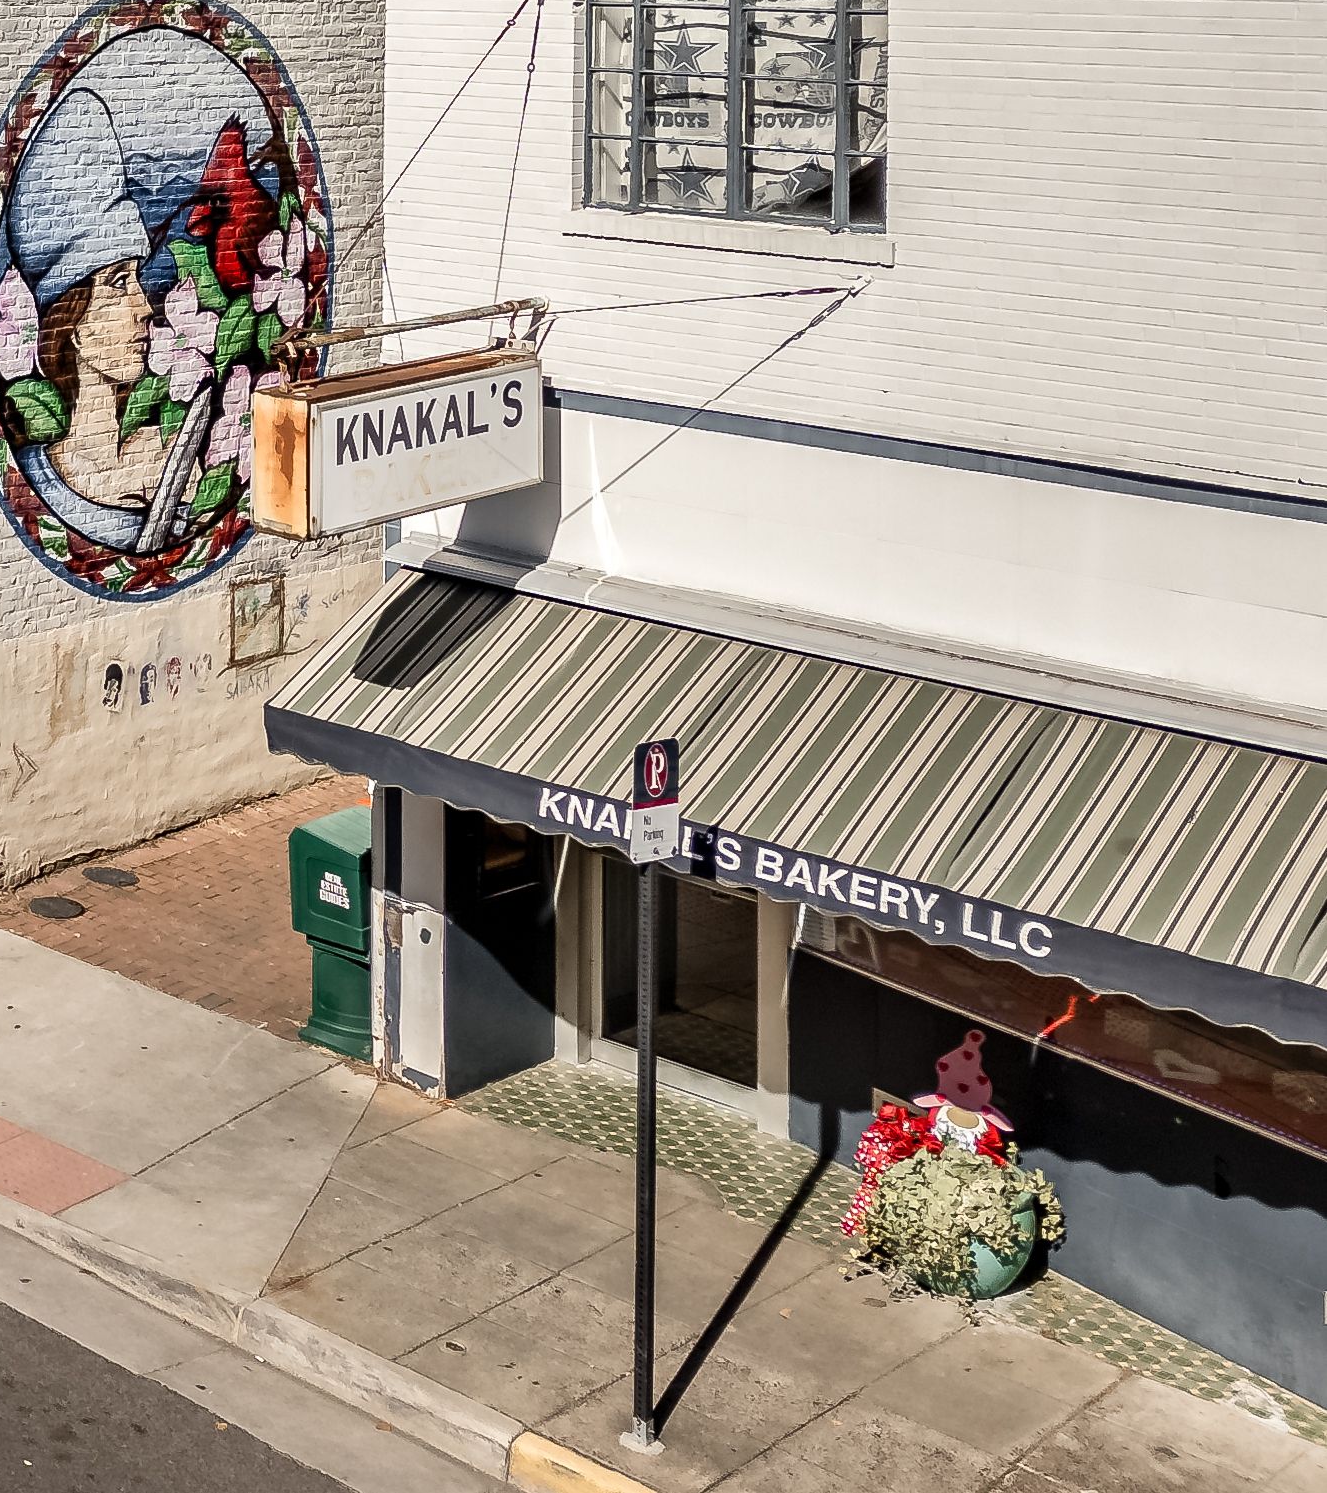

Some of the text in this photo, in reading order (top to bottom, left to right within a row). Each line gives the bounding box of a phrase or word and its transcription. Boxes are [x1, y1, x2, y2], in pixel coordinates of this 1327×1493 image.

[336, 380, 523, 467] KNAKAL'S
[643, 815, 652, 826] No
[537, 787, 1053, 958] KNAL'S BAKERY, LLC
[320, 879, 348, 898] ESTATE
[319, 889, 350, 910] GUIDES
